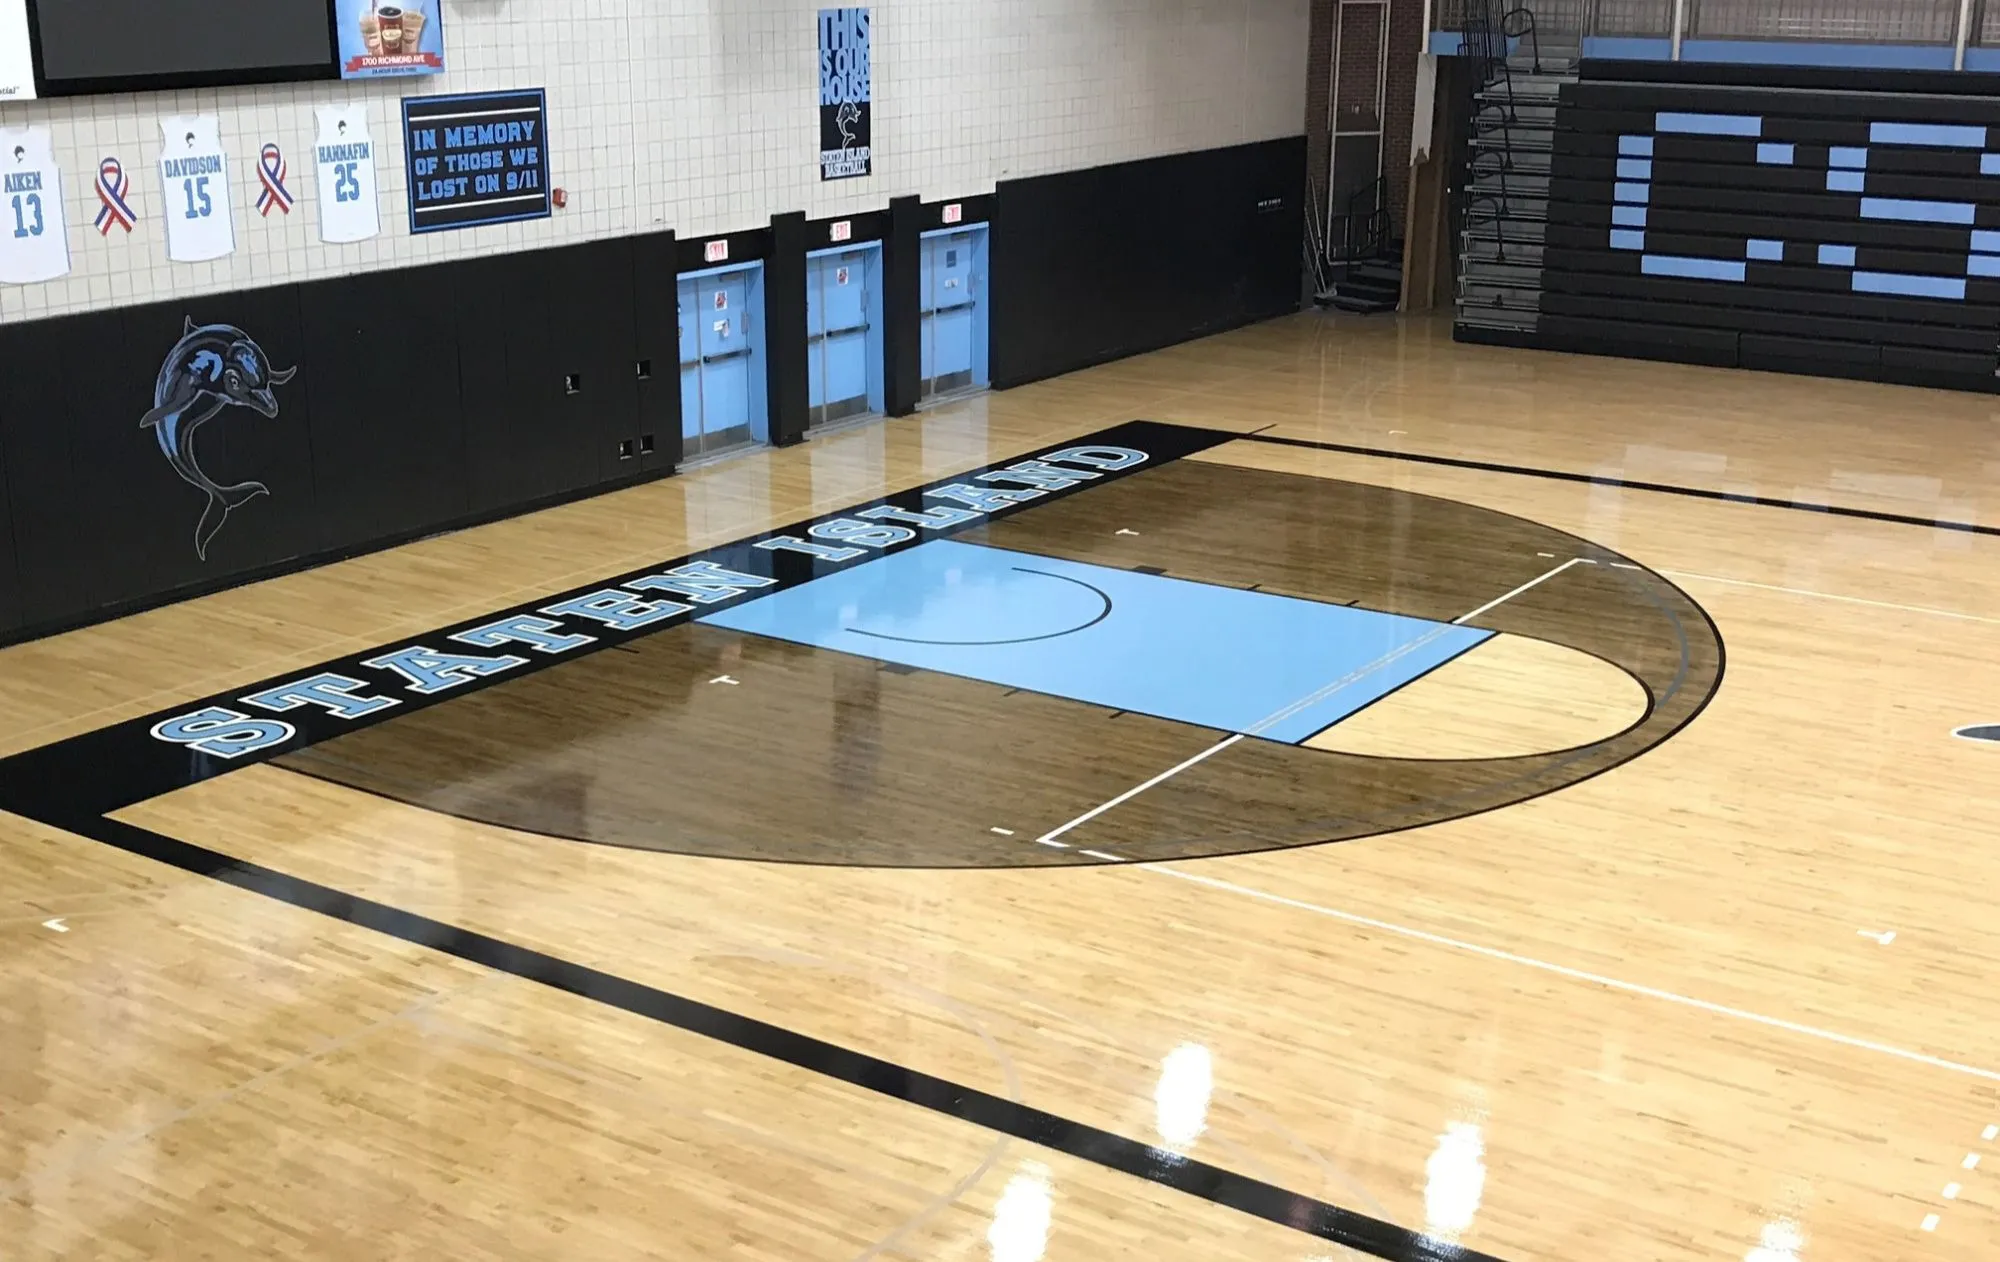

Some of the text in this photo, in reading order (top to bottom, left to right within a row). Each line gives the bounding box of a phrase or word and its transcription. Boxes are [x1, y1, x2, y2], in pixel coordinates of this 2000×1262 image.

[818, 8, 869, 50] THIS
[362, 54, 425, 66] 1700 RICHMOND AVE
[819, 48, 870, 76] IS OUR
[819, 75, 870, 105] HOUSE
[413, 120, 536, 151] IN MEMORY
[164, 155, 222, 178] DAVIDSON
[318, 142, 370, 163] HANNAFIN
[415, 147, 538, 176] OF THOSE WE
[4, 171, 42, 193] AIKEN
[334, 162, 360, 202] 25
[418, 169, 539, 200] LOST ON 9/11
[183, 177, 212, 219] 15
[12, 193, 44, 239] 13
[150, 445, 1149, 758] STATEN ISLAND
